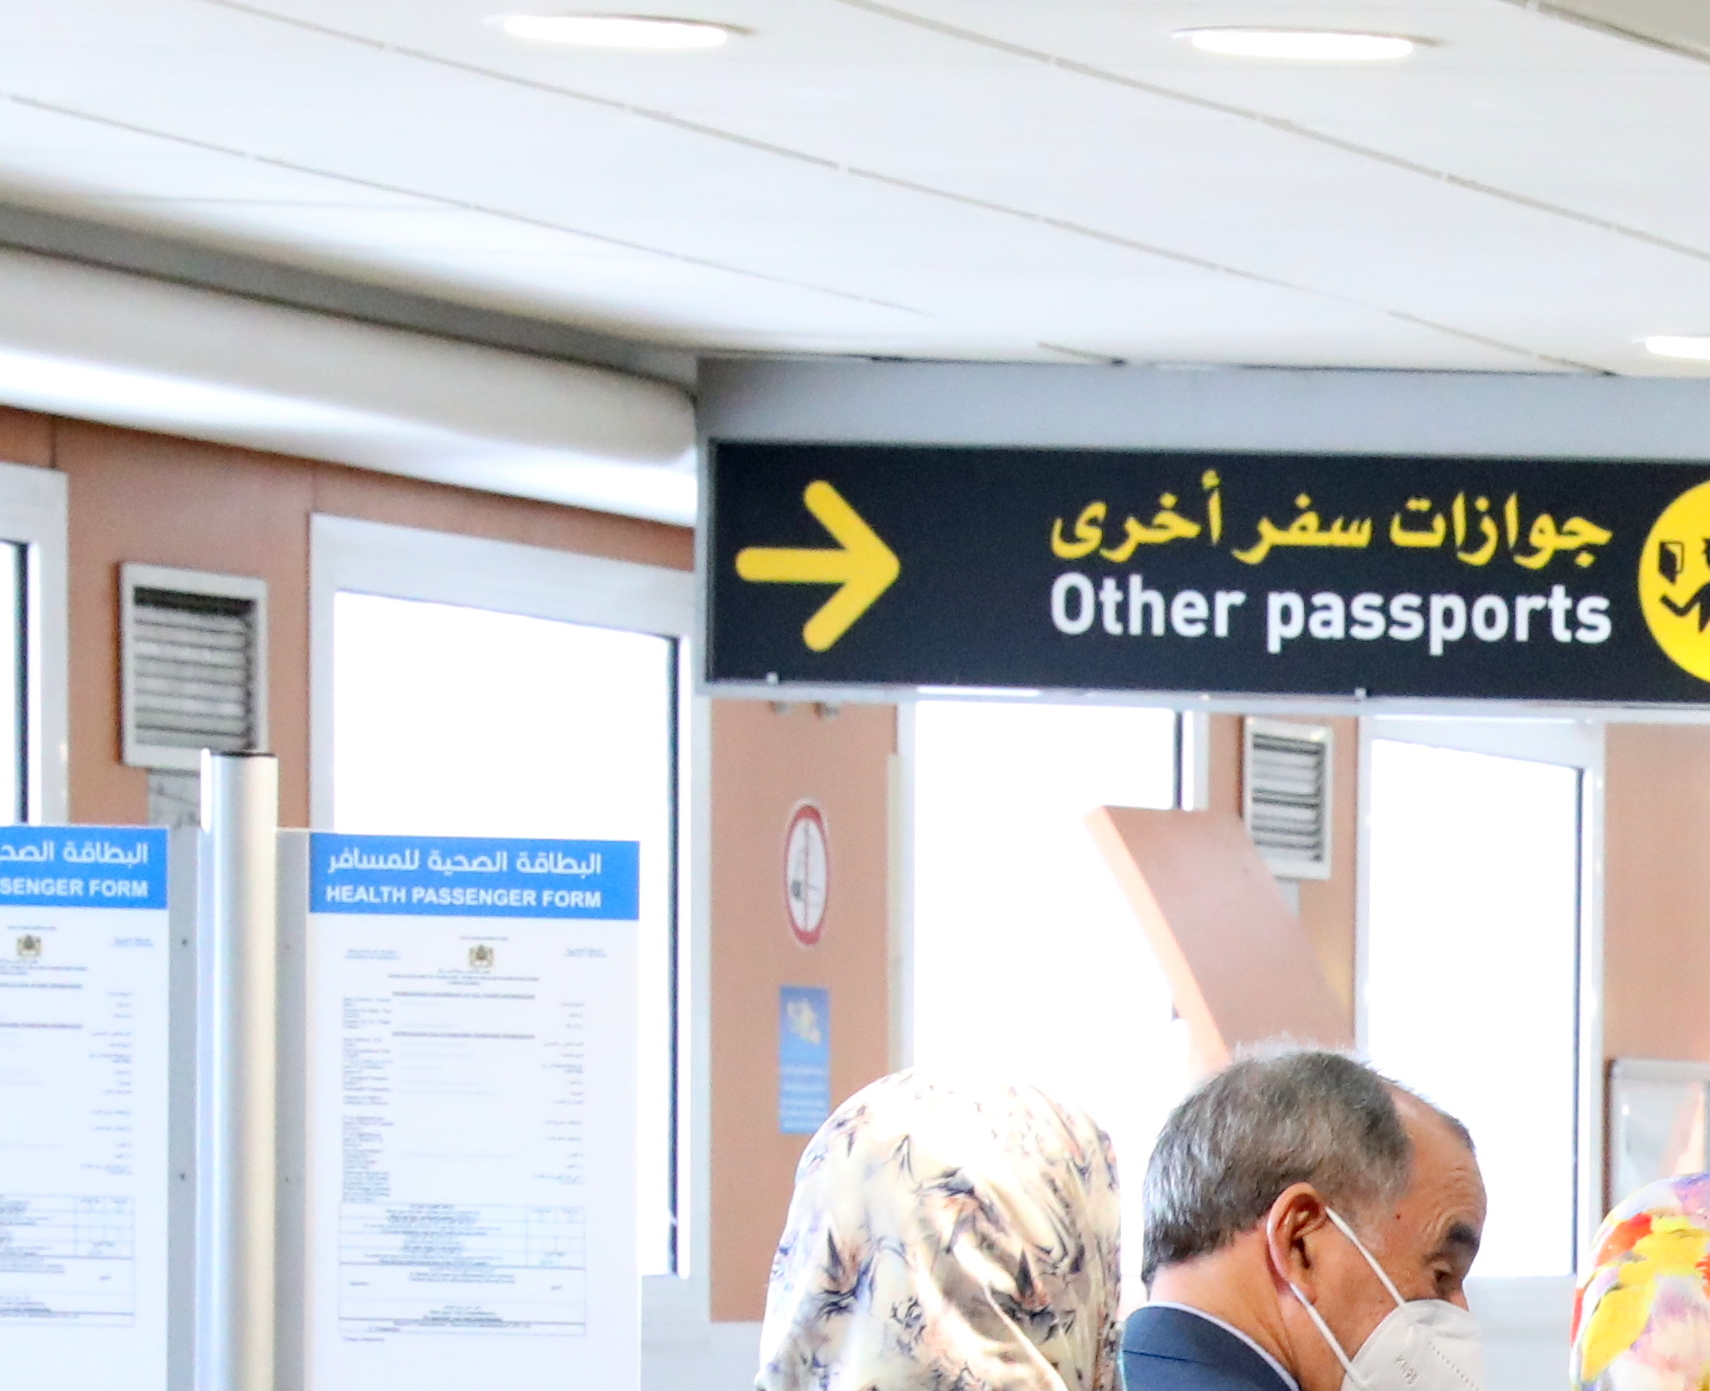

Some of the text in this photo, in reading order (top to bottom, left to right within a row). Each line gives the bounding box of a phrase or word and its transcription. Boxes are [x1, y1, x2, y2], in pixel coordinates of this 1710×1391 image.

[1050, 470, 1613, 569] جوازات سفر أخرى
[1050, 571, 1612, 657] Other passports
[63, 840, 148, 869] البطاقة
[327, 846, 602, 879] البطاقة الصحية للمسافر
[89, 878, 149, 898] FORM
[325, 884, 602, 909] HEALTH PASSENGER FORM
